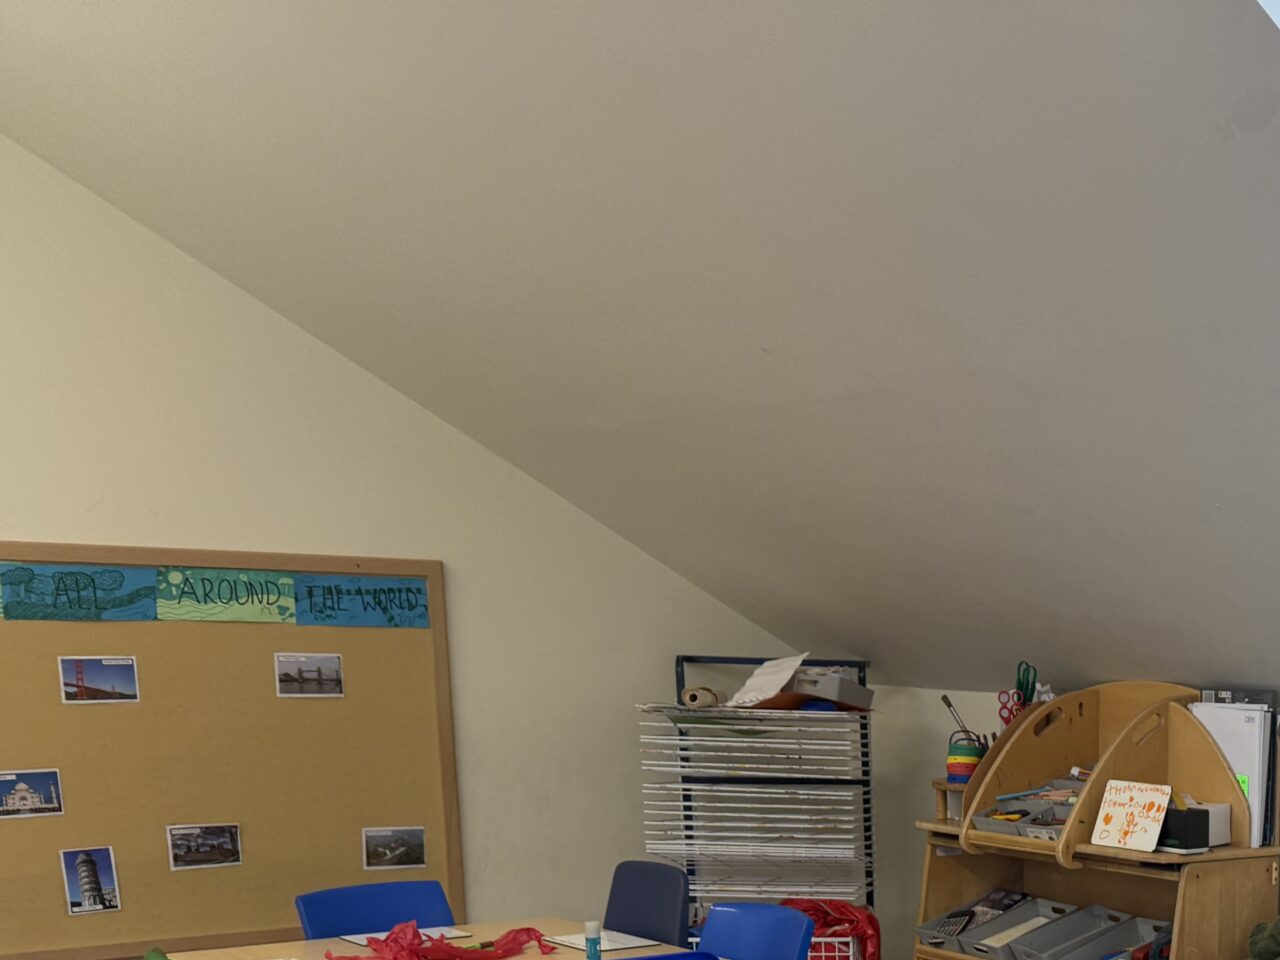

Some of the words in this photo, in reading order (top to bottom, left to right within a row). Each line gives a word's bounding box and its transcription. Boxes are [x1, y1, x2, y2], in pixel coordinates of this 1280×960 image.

[54, 577, 108, 610] ALL
[178, 577, 281, 606] AROUND
[305, 585, 348, 613] THE
[358, 586, 419, 612] WORLD
